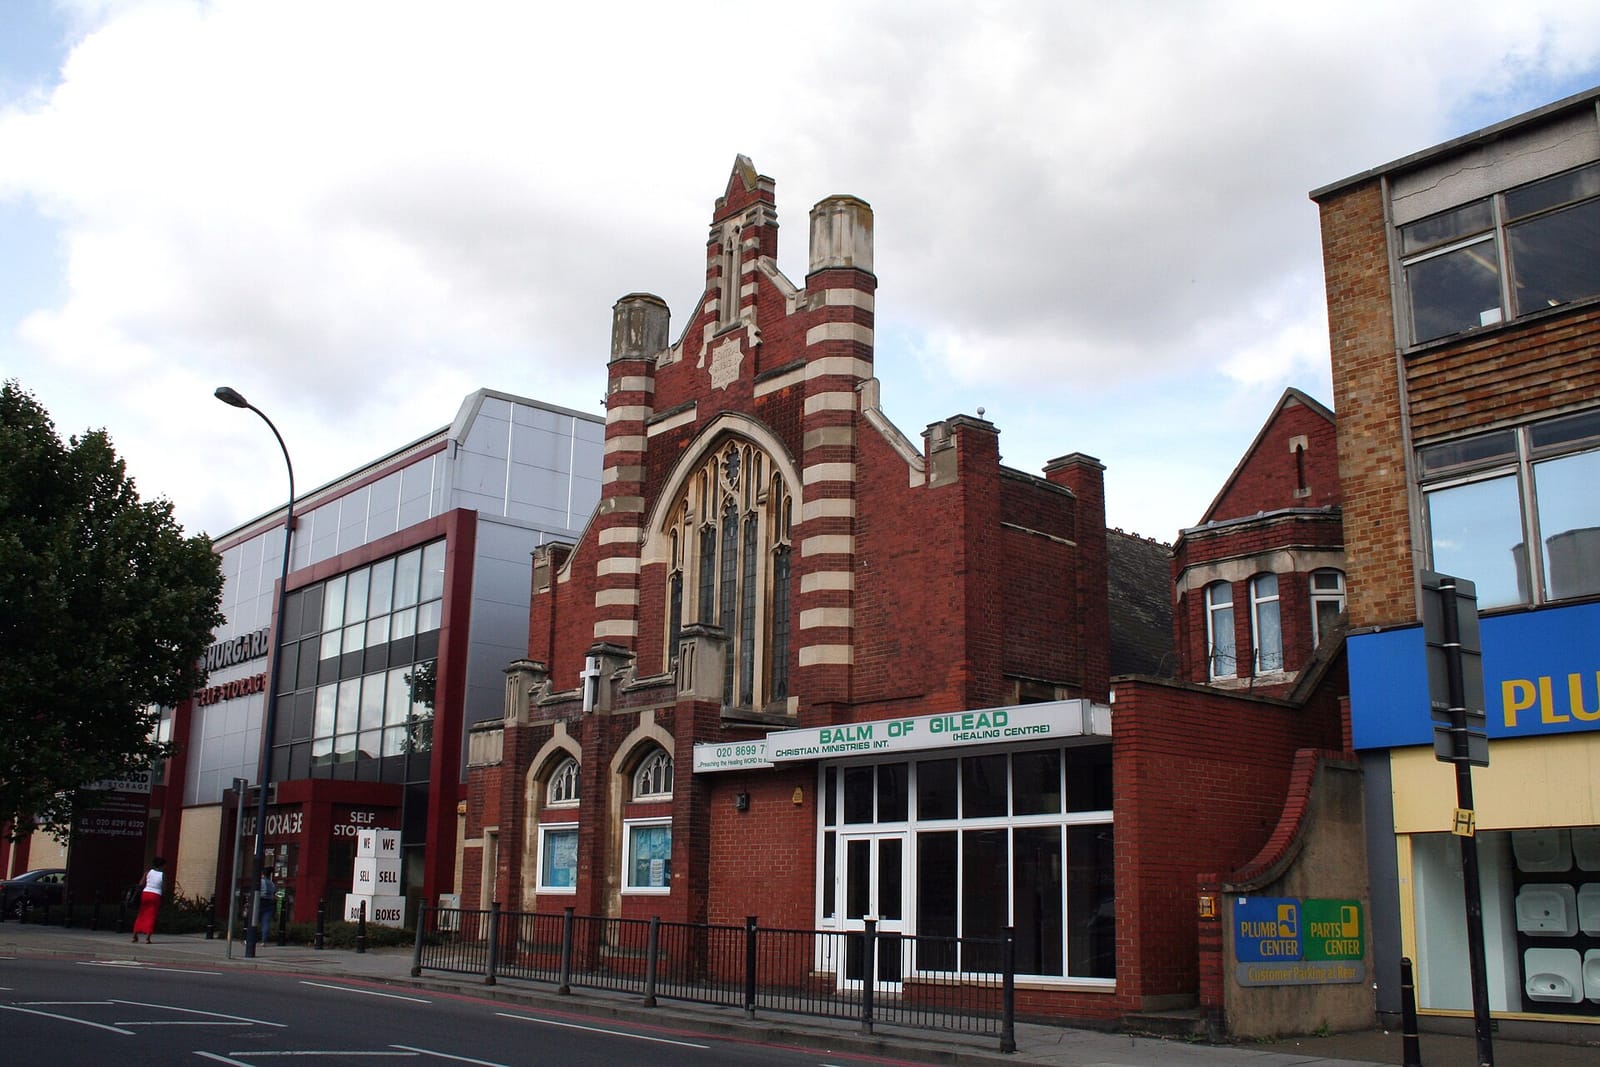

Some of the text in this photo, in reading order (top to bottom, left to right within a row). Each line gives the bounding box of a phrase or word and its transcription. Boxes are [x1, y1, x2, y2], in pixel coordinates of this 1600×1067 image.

[819, 711, 1008, 744] BALM OF GILEAD
[952, 724, 1050, 741] (HEALING CENTRE)
[716, 747, 733, 758] 020
[735, 745, 757, 756] 8699
[775, 740, 889, 757] CHRISTIAN MINISTRIES INT.
[350, 811, 375, 824] SELF
[1454, 811, 1472, 834] H
[363, 837, 371, 849] WE
[382, 838, 395, 850] WE
[359, 870, 370, 882] SELL
[379, 871, 397, 883] SELL
[375, 908, 401, 921] BOXES
[1241, 921, 1277, 938] PLUMB
[1310, 922, 1341, 938] PARTS
[1259, 940, 1299, 956] CENTER
[1325, 940, 1360, 956] CENTER
[1247, 967, 1290, 981] Customer
[1293, 966, 1326, 983] Parking
